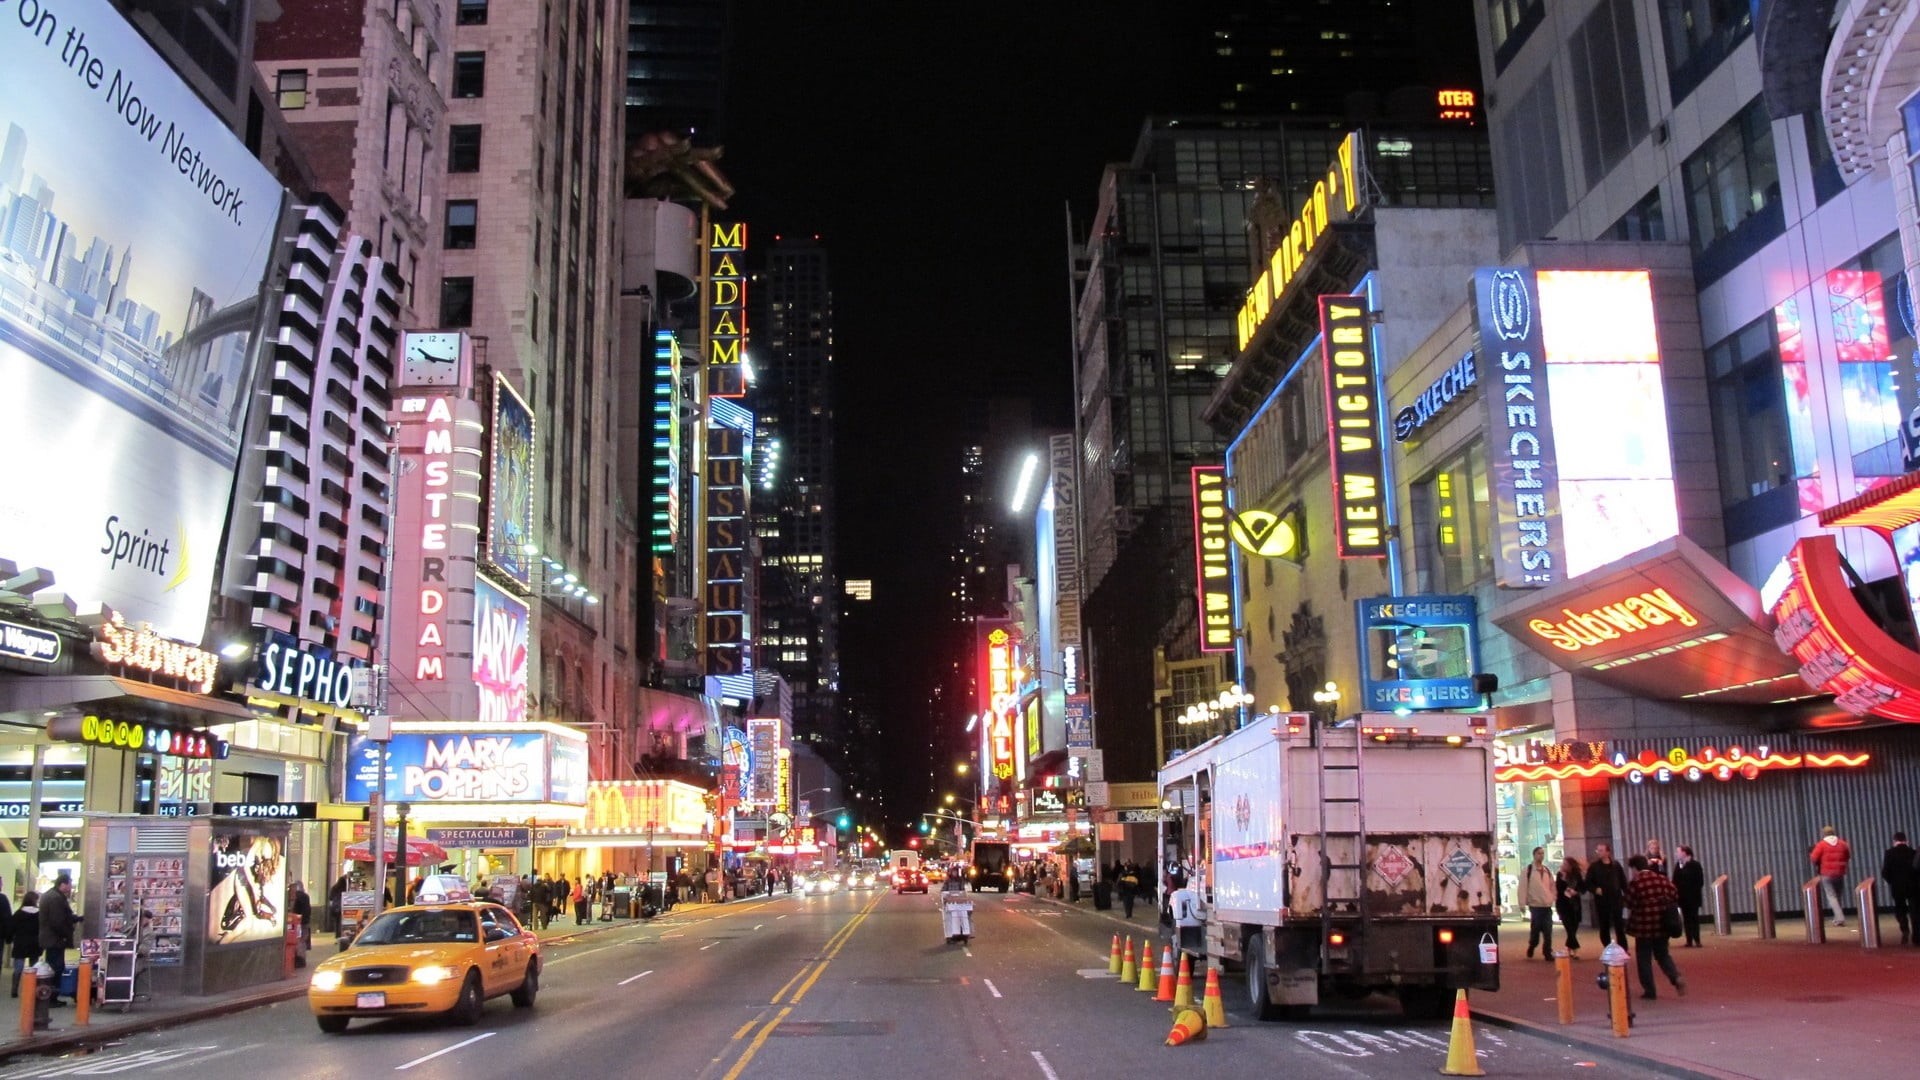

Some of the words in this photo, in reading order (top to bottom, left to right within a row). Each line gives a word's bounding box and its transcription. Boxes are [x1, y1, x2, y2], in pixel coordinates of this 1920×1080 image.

[18, 0, 57, 46] on
[61, 27, 104, 90] the
[106, 69, 162, 142] Now
[161, 122, 242, 226] Network.
[1329, 304, 1372, 453] VICTORY
[1051, 436, 1073, 469] NEW
[1501, 351, 1551, 571] SKECHERS
[416, 398, 452, 680] AMSTERDAM
[1199, 473, 1227, 578] VICTORY
[1343, 474, 1380, 547] NEW
[101, 515, 170, 576] Sprint
[1204, 592, 1231, 644] NEW
[1369, 602, 1467, 619] SKECHERS
[1529, 587, 1698, 651] Subway
[262, 643, 353, 709] SEPHO
[1375, 685, 1470, 702] SKECHERS
[405, 763, 529, 799] POPPINS
[424, 737, 512, 770] MARY
[231, 805, 298, 817] SEPHORA
[20, 838, 74, 851] SUDIO
